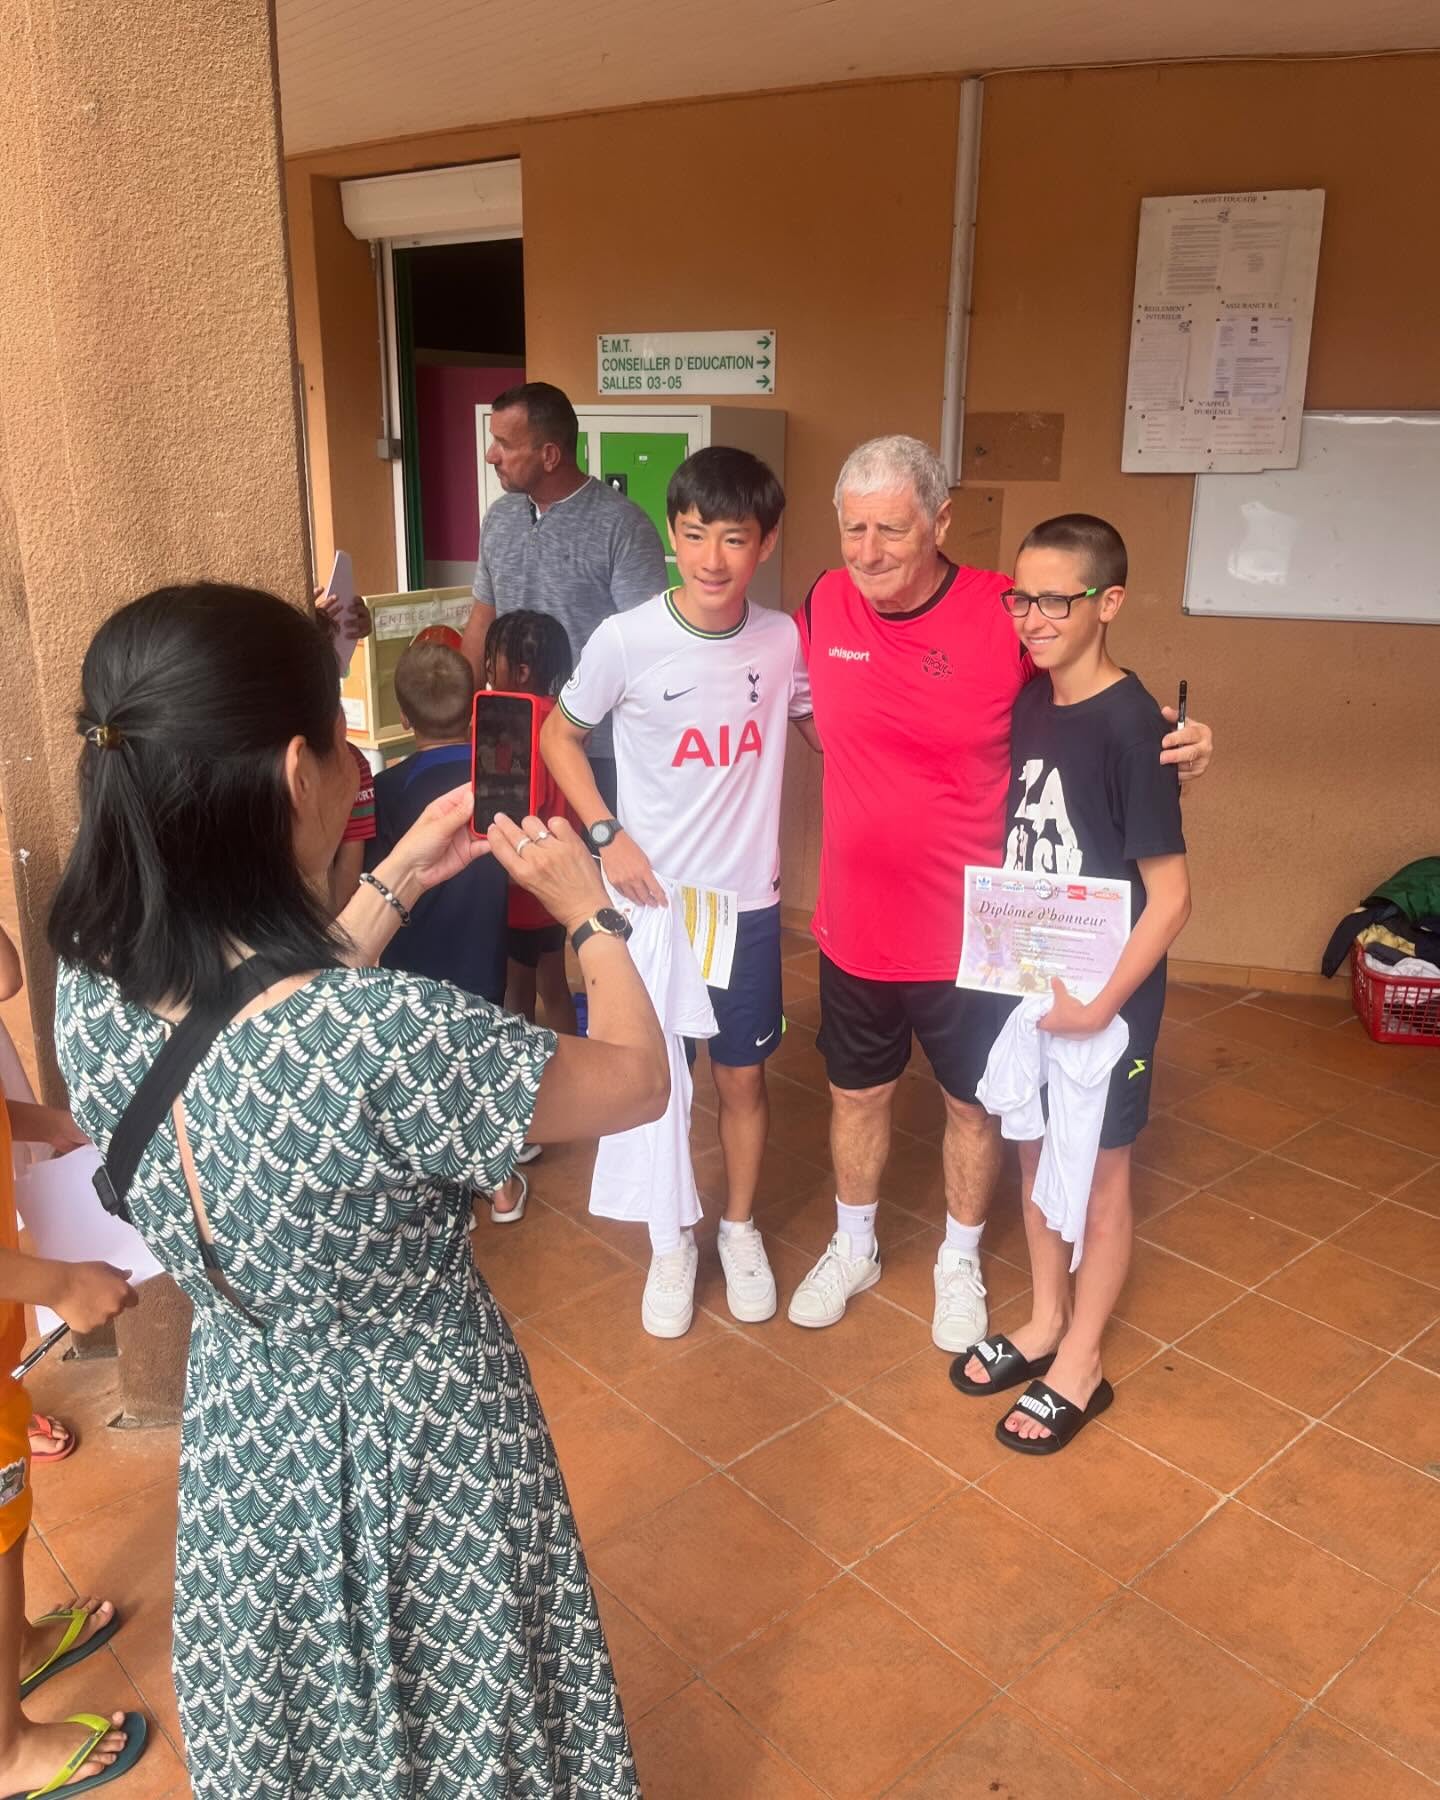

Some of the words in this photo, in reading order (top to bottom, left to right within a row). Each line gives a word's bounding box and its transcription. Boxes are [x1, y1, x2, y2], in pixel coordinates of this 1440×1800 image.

[601, 338, 633, 354] E.M.T.
[601, 356, 671, 372] CONSEILLER
[674, 355, 754, 371] D'EDUCATION
[601, 375, 642, 390] SALLES
[647, 375, 682, 390] 03-05
[828, 646, 870, 662] uhlsport
[671, 719, 762, 768] AIA
[978, 900, 1035, 920] Diplôme
[1017, 1394, 1052, 1420] PUMA
